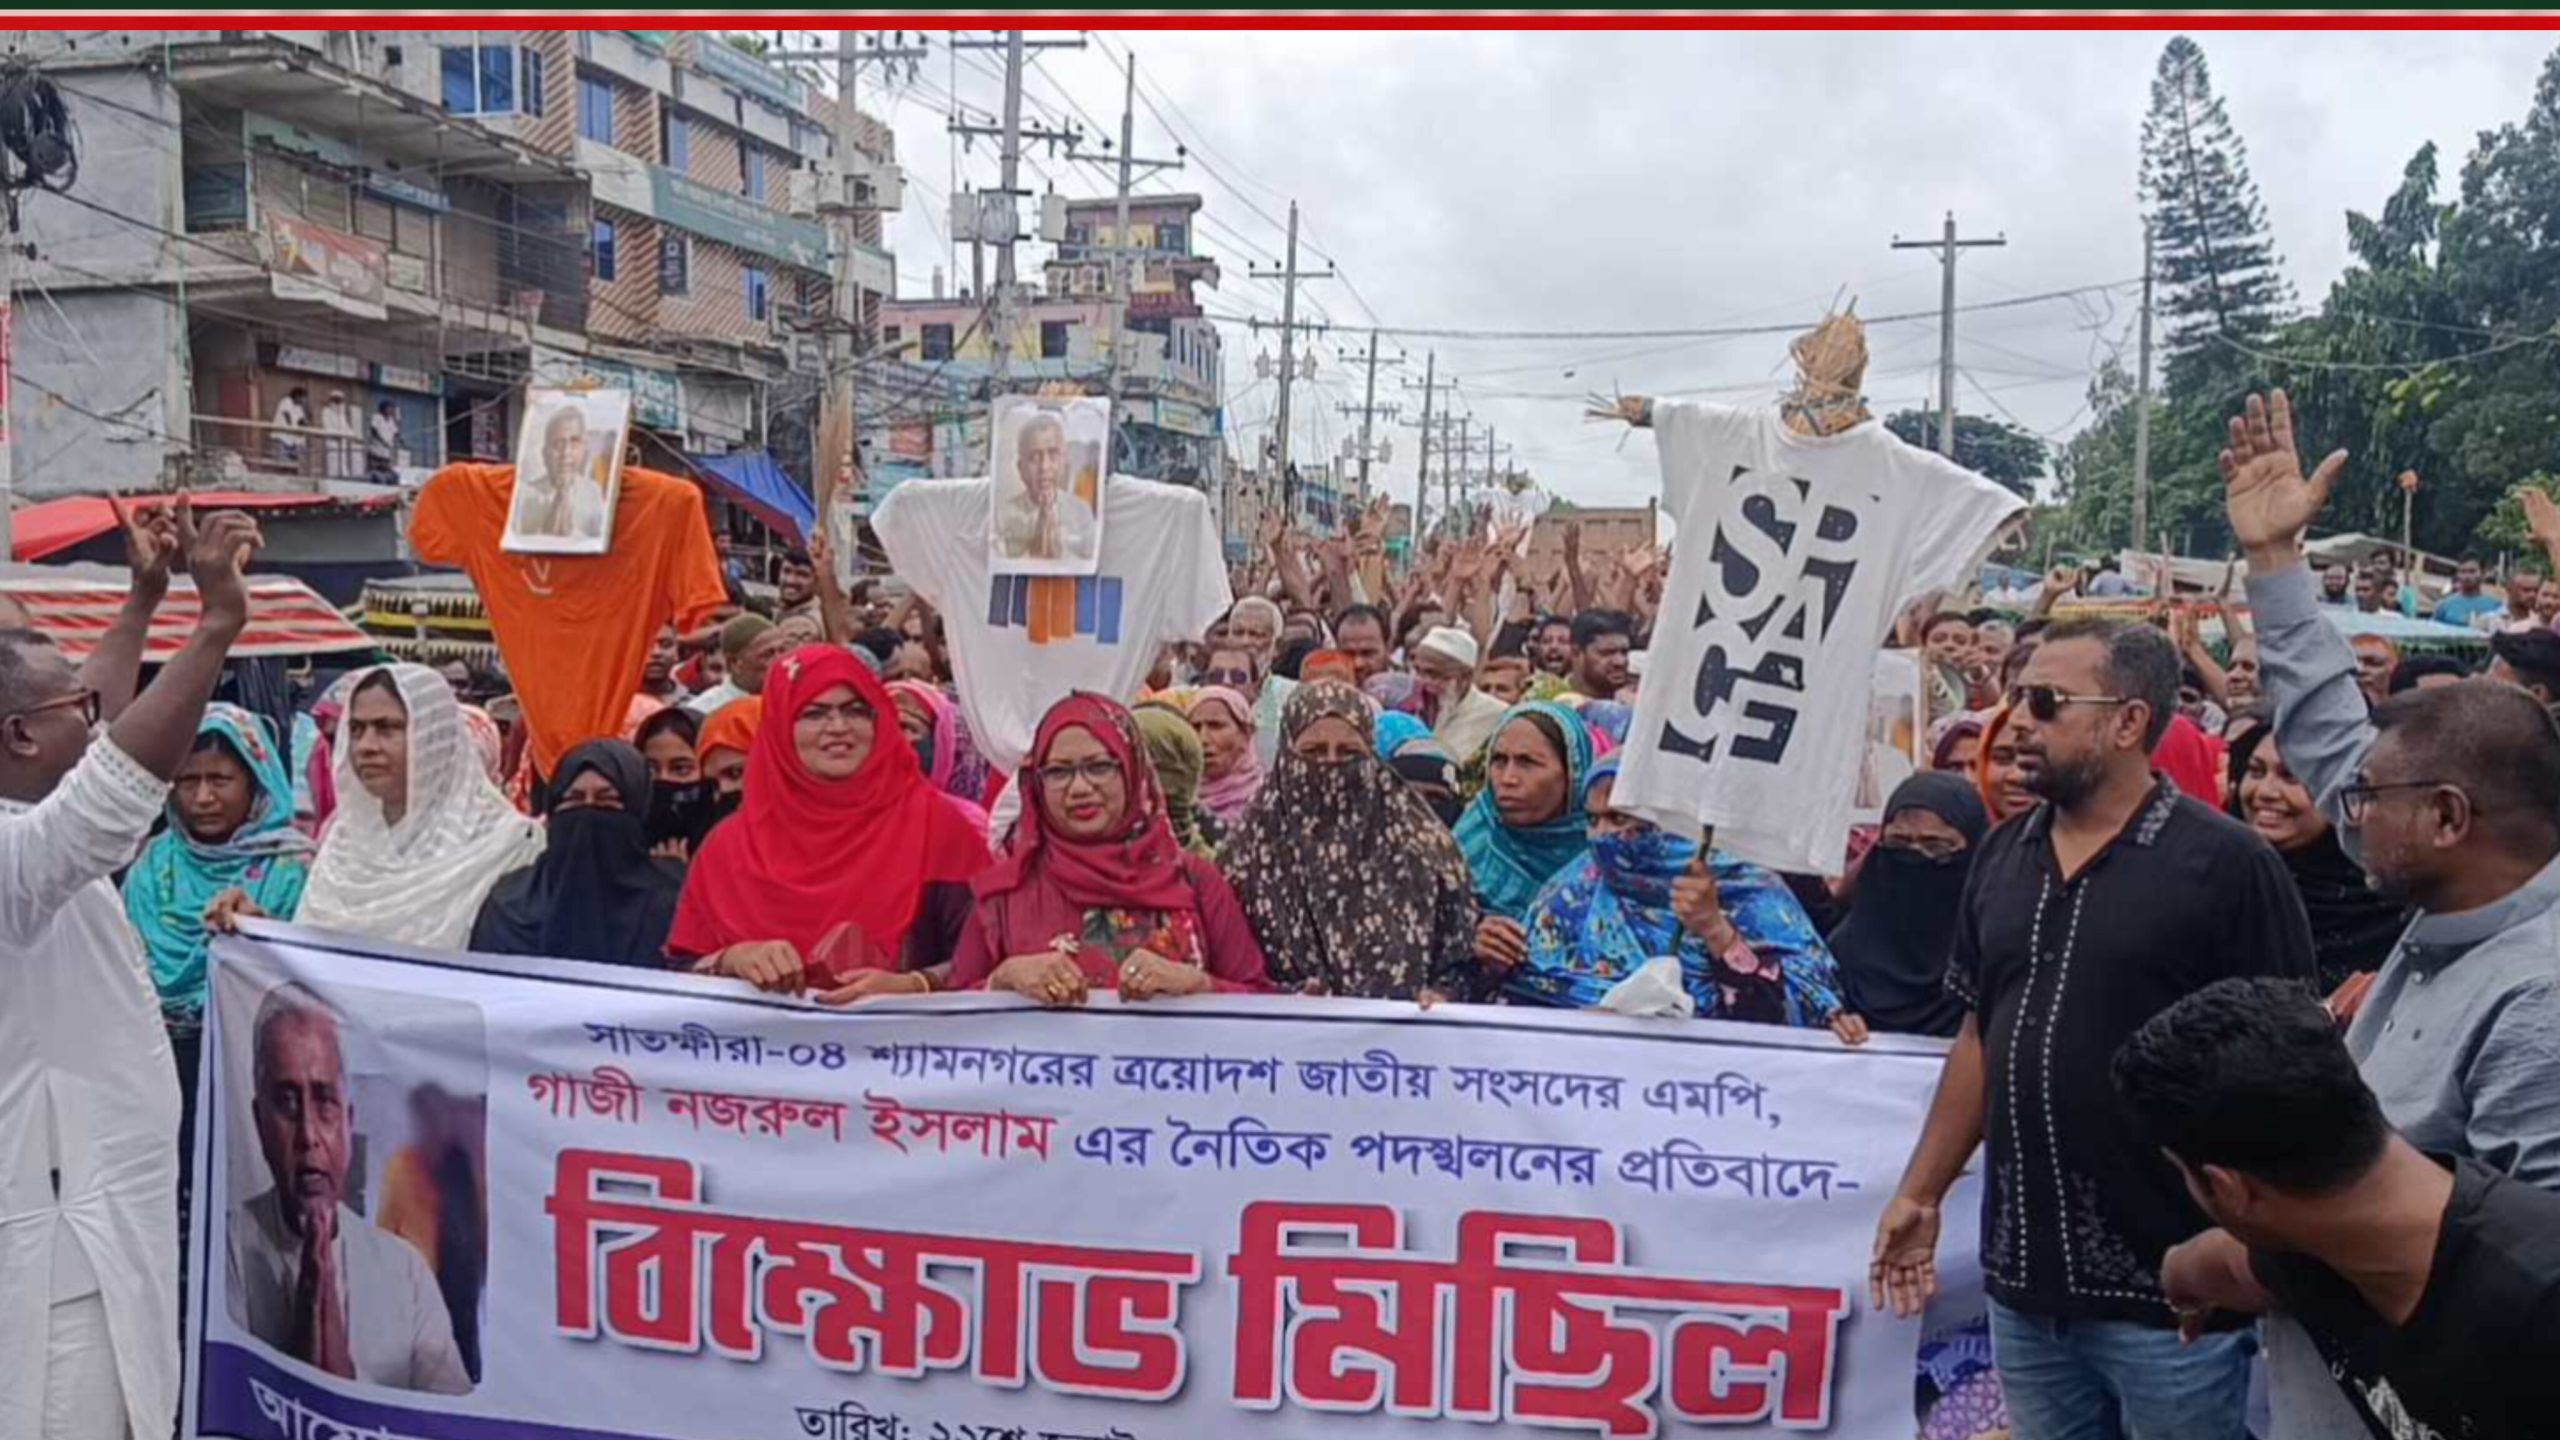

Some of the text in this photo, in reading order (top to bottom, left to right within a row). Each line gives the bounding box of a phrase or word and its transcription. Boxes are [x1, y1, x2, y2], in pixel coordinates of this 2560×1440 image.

[526, 1066, 1861, 1201] গাজী নজরুল ইসলাম এর নৈতিক পদস্খলনের প্রতিবাদে-
[583, 1021, 1781, 1128] সাতক্ষীরা-০৪ শ্যামনগরের ত্রয়োদশ জাতীয় সংসদের এমপি,
[544, 1147, 1846, 1438] বিক্ষোভ মিছিল
